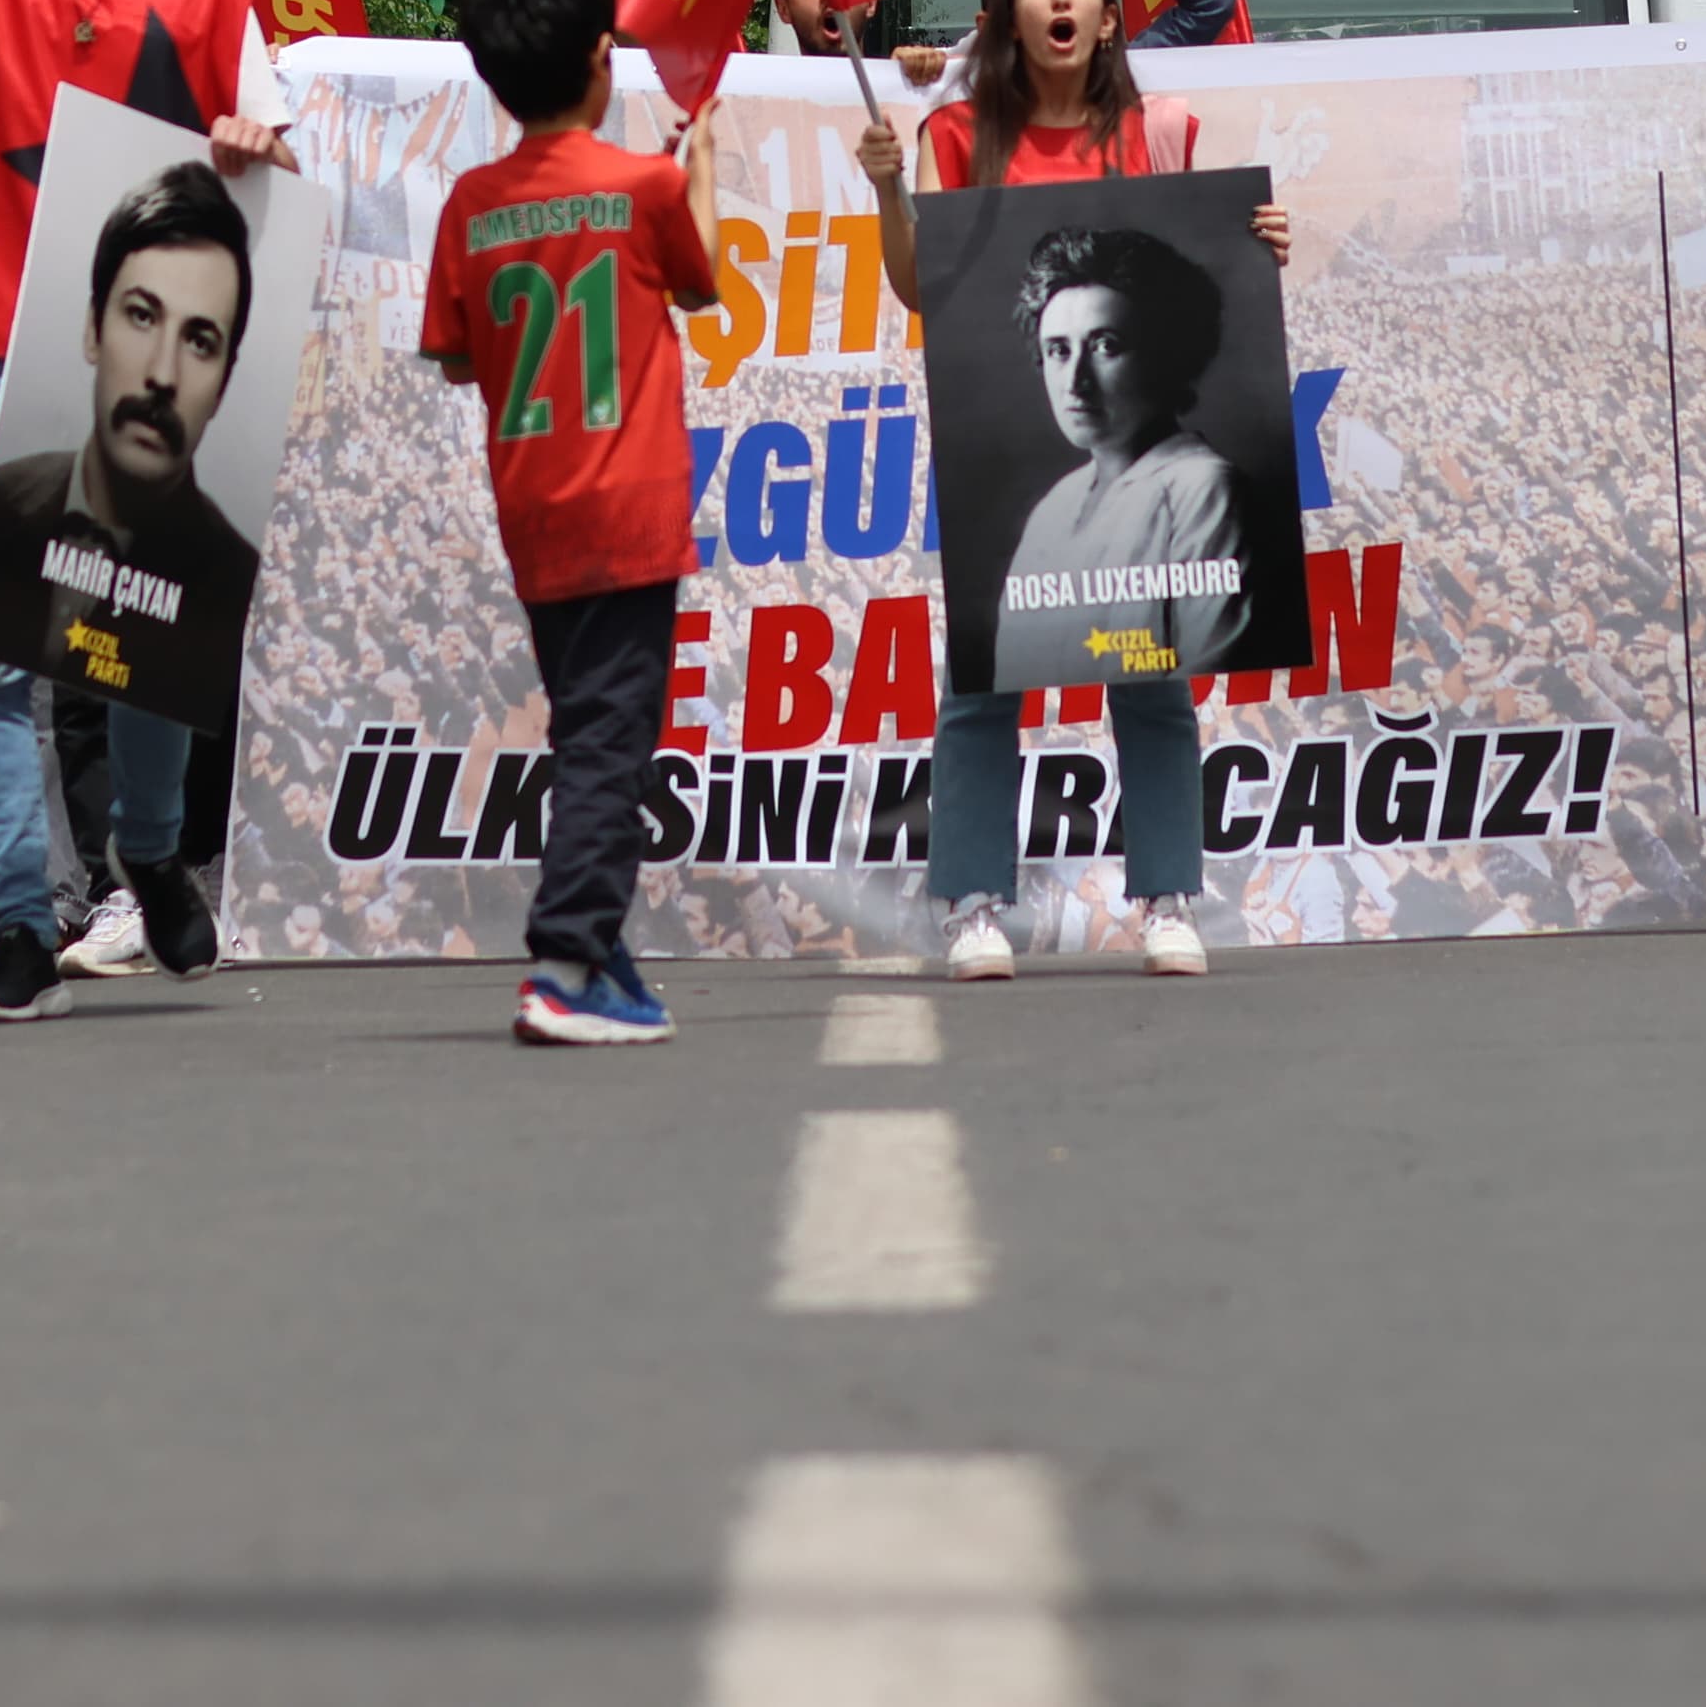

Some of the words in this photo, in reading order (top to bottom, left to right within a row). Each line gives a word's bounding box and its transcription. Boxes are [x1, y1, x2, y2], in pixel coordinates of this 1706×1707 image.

[466, 191, 634, 256] AMEDSPOR
[487, 248, 621, 443] 21
[41, 539, 116, 601] MAHİR
[111, 565, 183, 625] ÇAYAN
[1006, 571, 1077, 612] ROSA
[1081, 557, 1242, 606] LUXEMBURG
[1107, 628, 1157, 651] KIZIL
[1122, 647, 1178, 674] PARTİ
